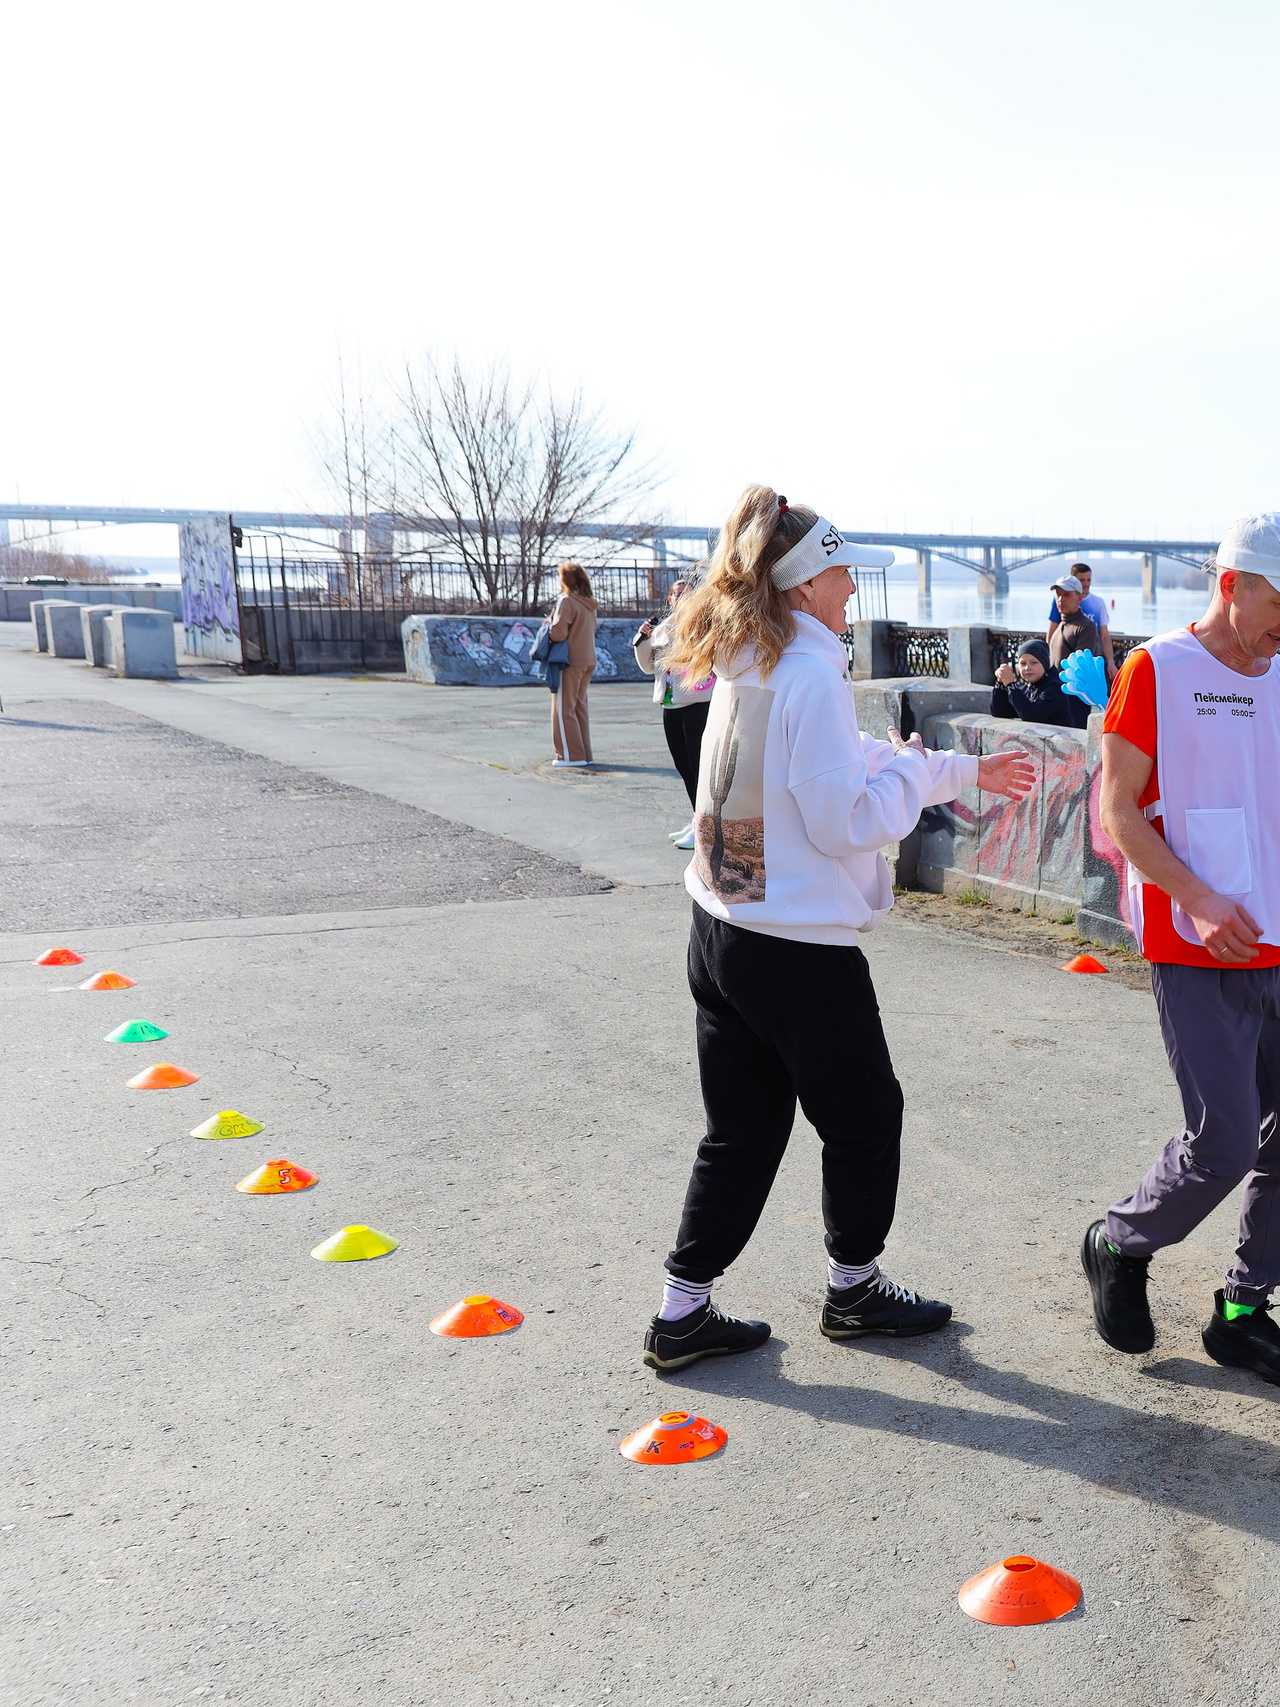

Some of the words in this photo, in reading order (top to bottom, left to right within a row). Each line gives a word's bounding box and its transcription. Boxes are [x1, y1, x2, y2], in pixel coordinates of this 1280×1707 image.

[1194, 692, 1254, 707] Пейсмейкер
[1197, 708, 1217, 716] 25:00
[1231, 709, 1249, 718] 05:00
